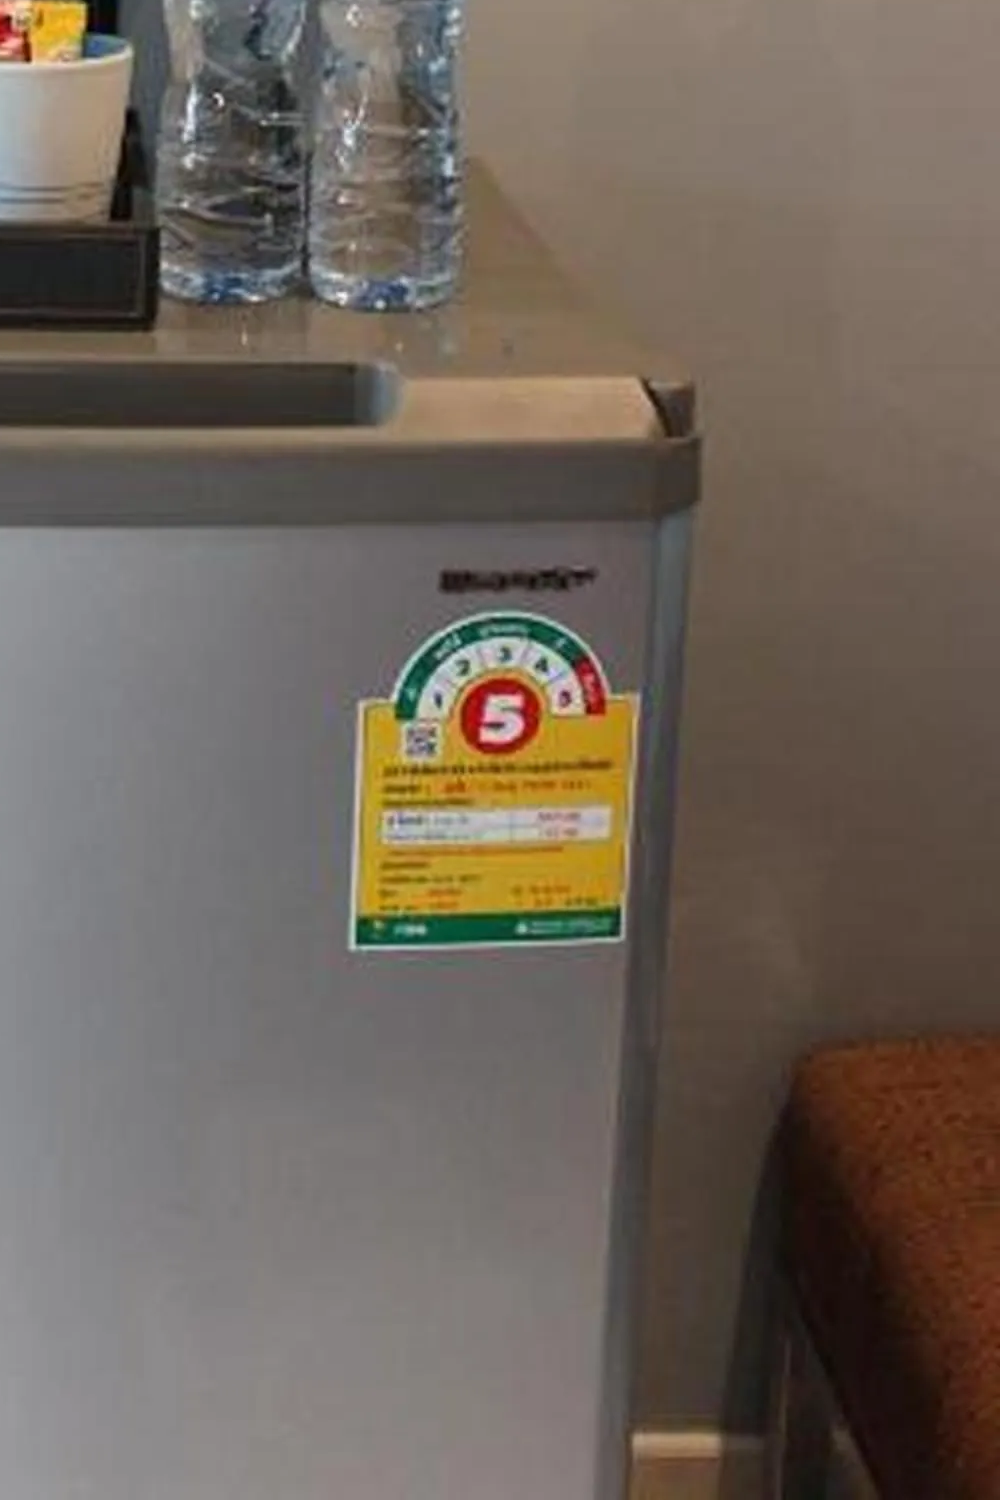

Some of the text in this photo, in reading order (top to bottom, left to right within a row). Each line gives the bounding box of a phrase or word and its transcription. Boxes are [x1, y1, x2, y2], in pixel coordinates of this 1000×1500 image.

[455, 658, 471, 677] 2
[498, 646, 513, 663] 3
[535, 658, 549, 674] 4
[479, 692, 526, 745] 5
